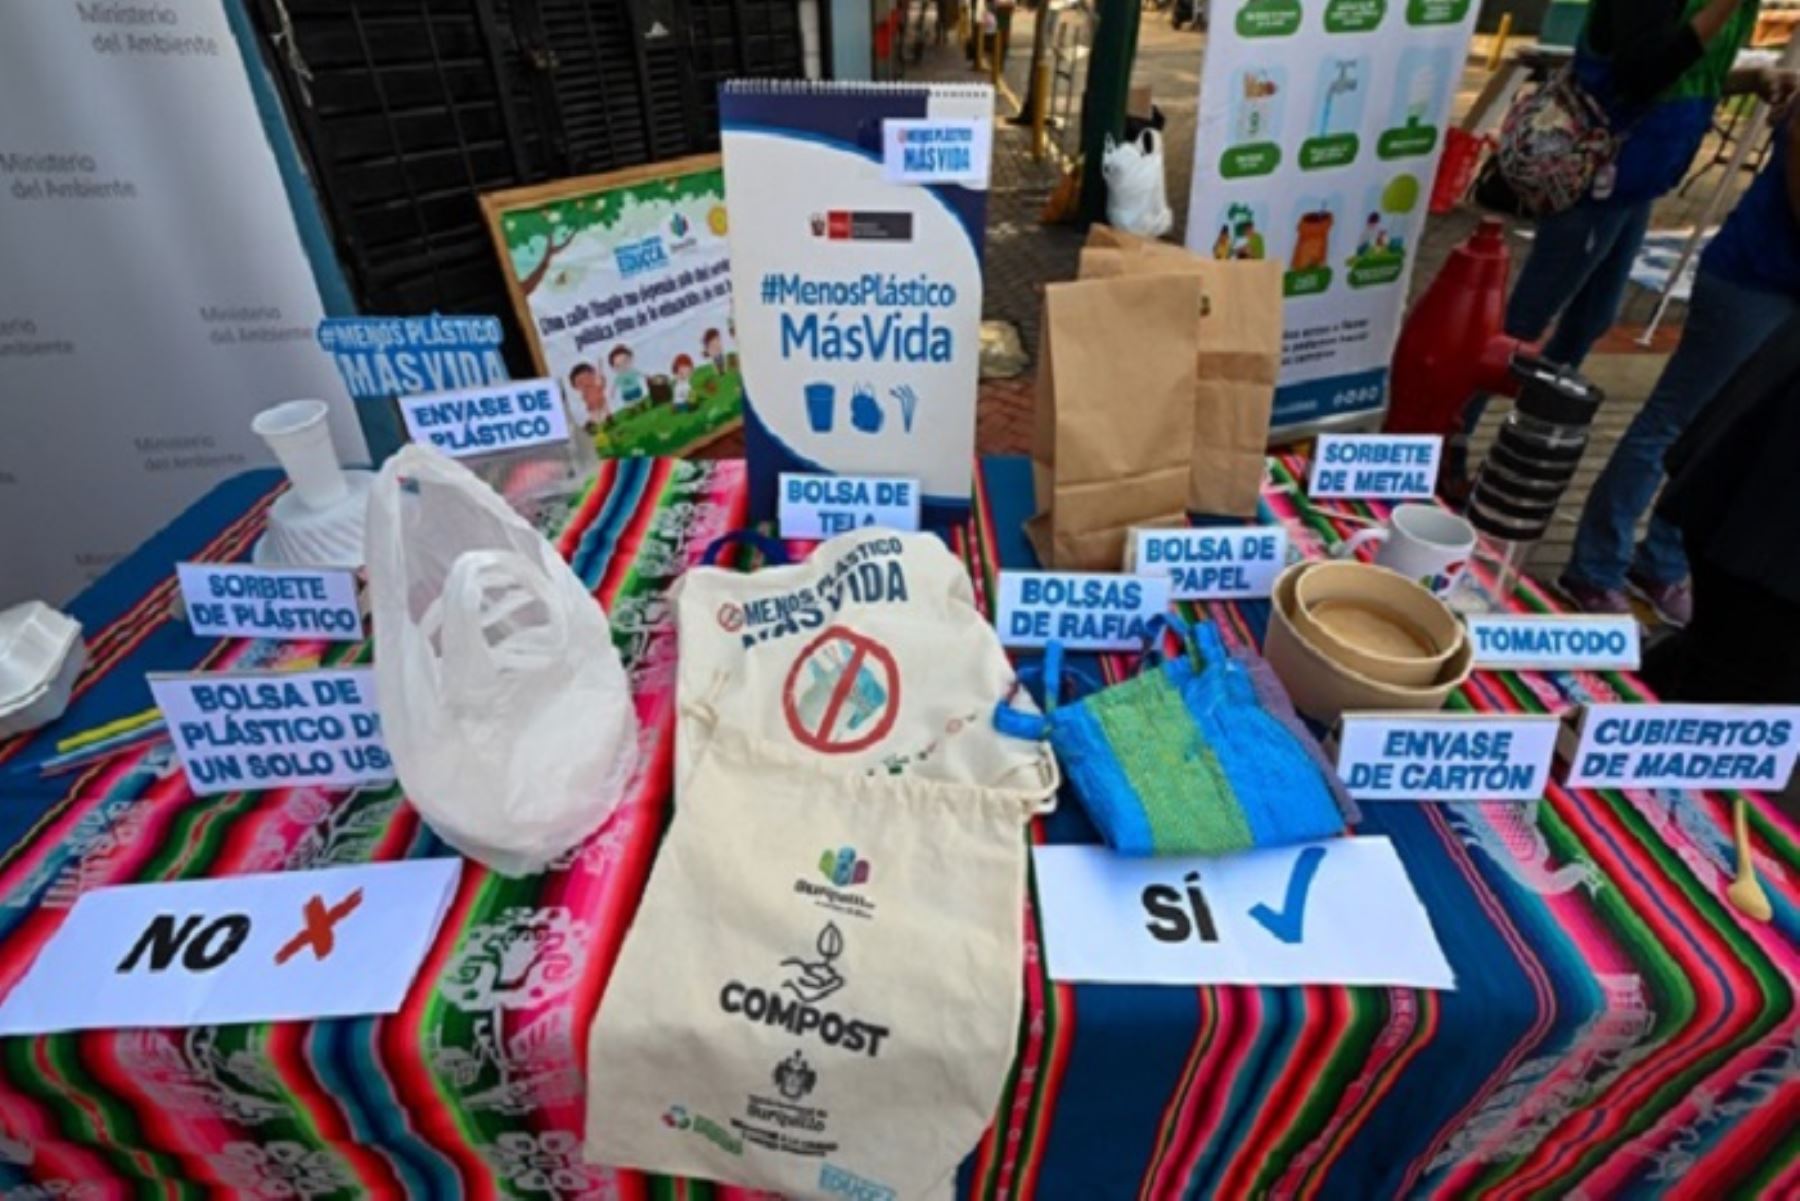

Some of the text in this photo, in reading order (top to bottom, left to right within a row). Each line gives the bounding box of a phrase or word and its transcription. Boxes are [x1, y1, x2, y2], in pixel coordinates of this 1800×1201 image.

[761, 273, 957, 308] #MenosPlástico
[319, 310, 500, 349] #MENOS PLÁSTICO
[780, 311, 953, 363] MásVida
[338, 343, 506, 397] MÁS VIDA
[415, 389, 553, 427] ENVASE DE
[429, 414, 551, 450] PLÁSTICO
[1324, 443, 1432, 465] SORBETE
[787, 479, 910, 506] BOLSA DE
[1317, 469, 1431, 493] DE METAL
[1145, 536, 1276, 563] BOLSA DE
[208, 574, 328, 600] SORBETE
[826, 559, 908, 612] VIDA
[1020, 576, 1142, 610] BOLSAS
[1169, 567, 1250, 592] PAPEL
[191, 601, 357, 632] DE PLÁSTICO
[1011, 611, 1050, 637] DE
[1475, 626, 1627, 655] TOMATODO
[190, 678, 362, 714] BOLSA DE
[178, 714, 345, 749] PLÁSTICO
[1382, 731, 1512, 761] ENVASE
[1593, 719, 1791, 747] CUBIERTOS
[187, 754, 243, 785] UN
[245, 749, 335, 778] SOLO
[1348, 757, 1535, 791] DE CARTÓN
[1581, 752, 1778, 780] DE MADERA
[1141, 870, 1220, 942] SÍ
[115, 913, 252, 974] NO
[719, 980, 890, 1057] COMPOST
